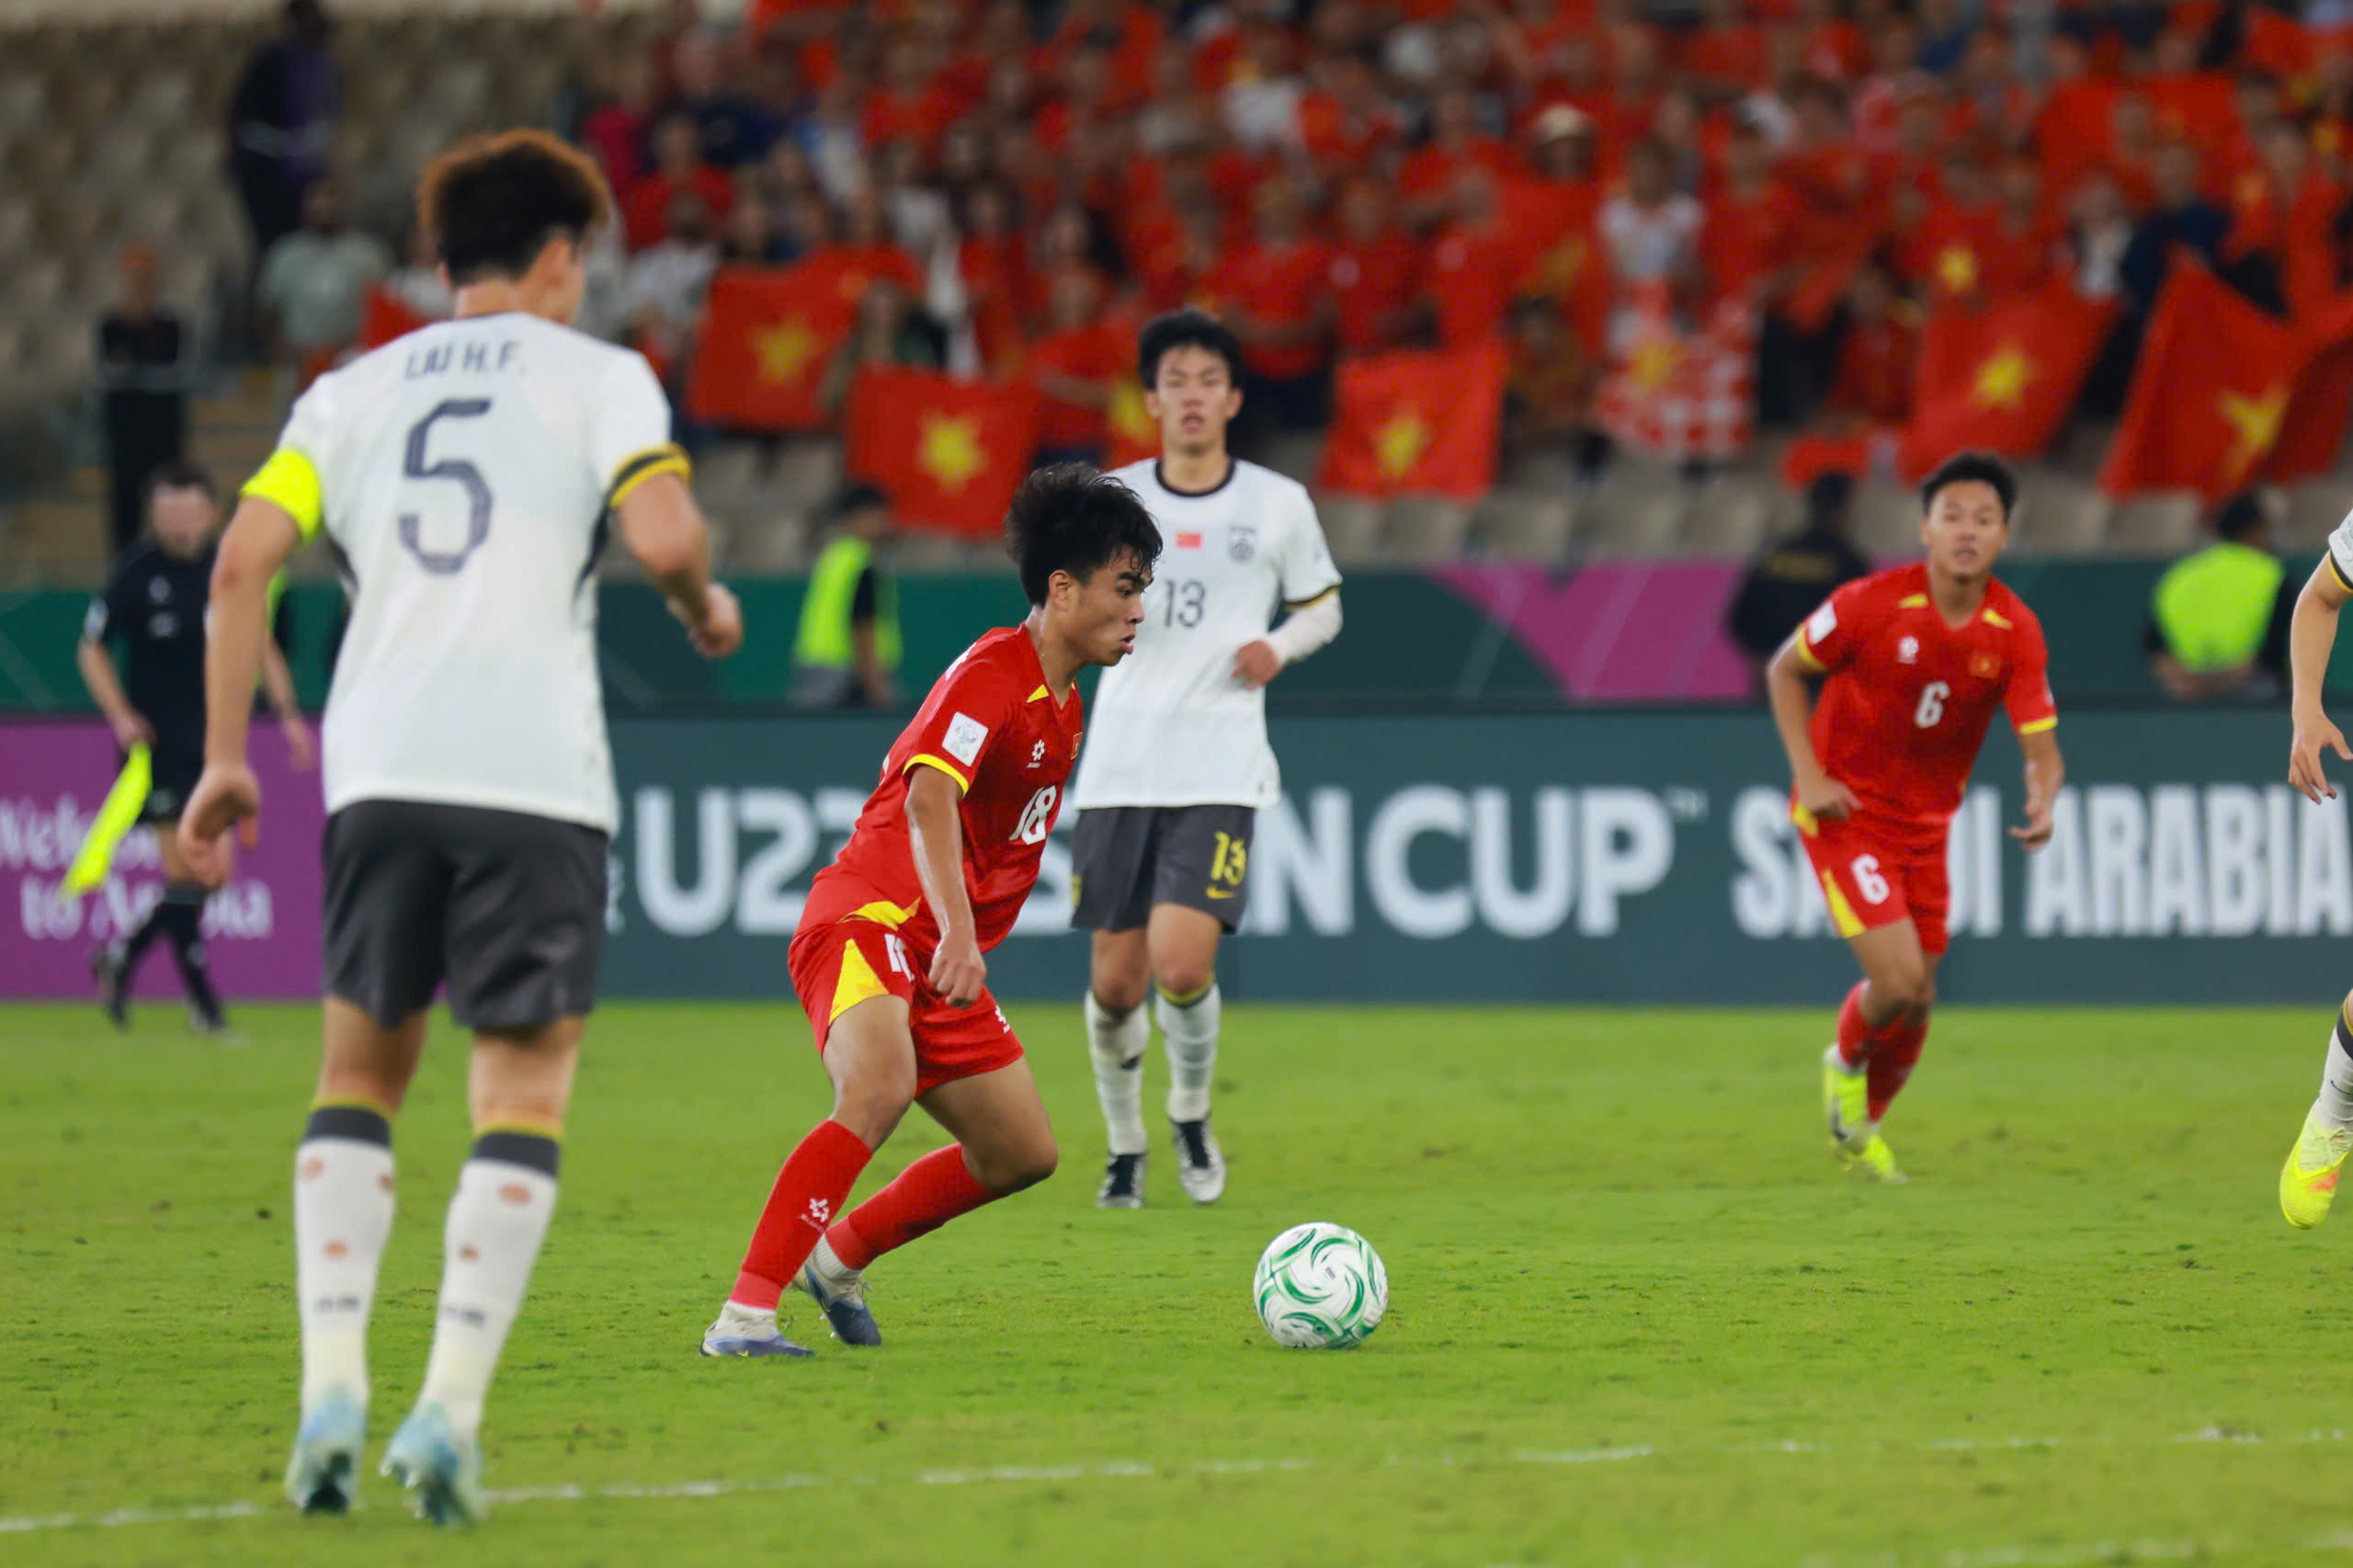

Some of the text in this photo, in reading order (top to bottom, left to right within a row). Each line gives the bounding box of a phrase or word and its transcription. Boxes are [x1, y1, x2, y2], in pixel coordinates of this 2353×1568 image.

[397, 396, 494, 576] 5
[1164, 578, 1208, 629] 13
[1915, 679, 1950, 729] 6
[1008, 785, 1057, 845] 18
[1211, 830, 1247, 887] 13
[1850, 852, 1891, 905] 6
[2024, 784, 2353, 938] ARABIA
